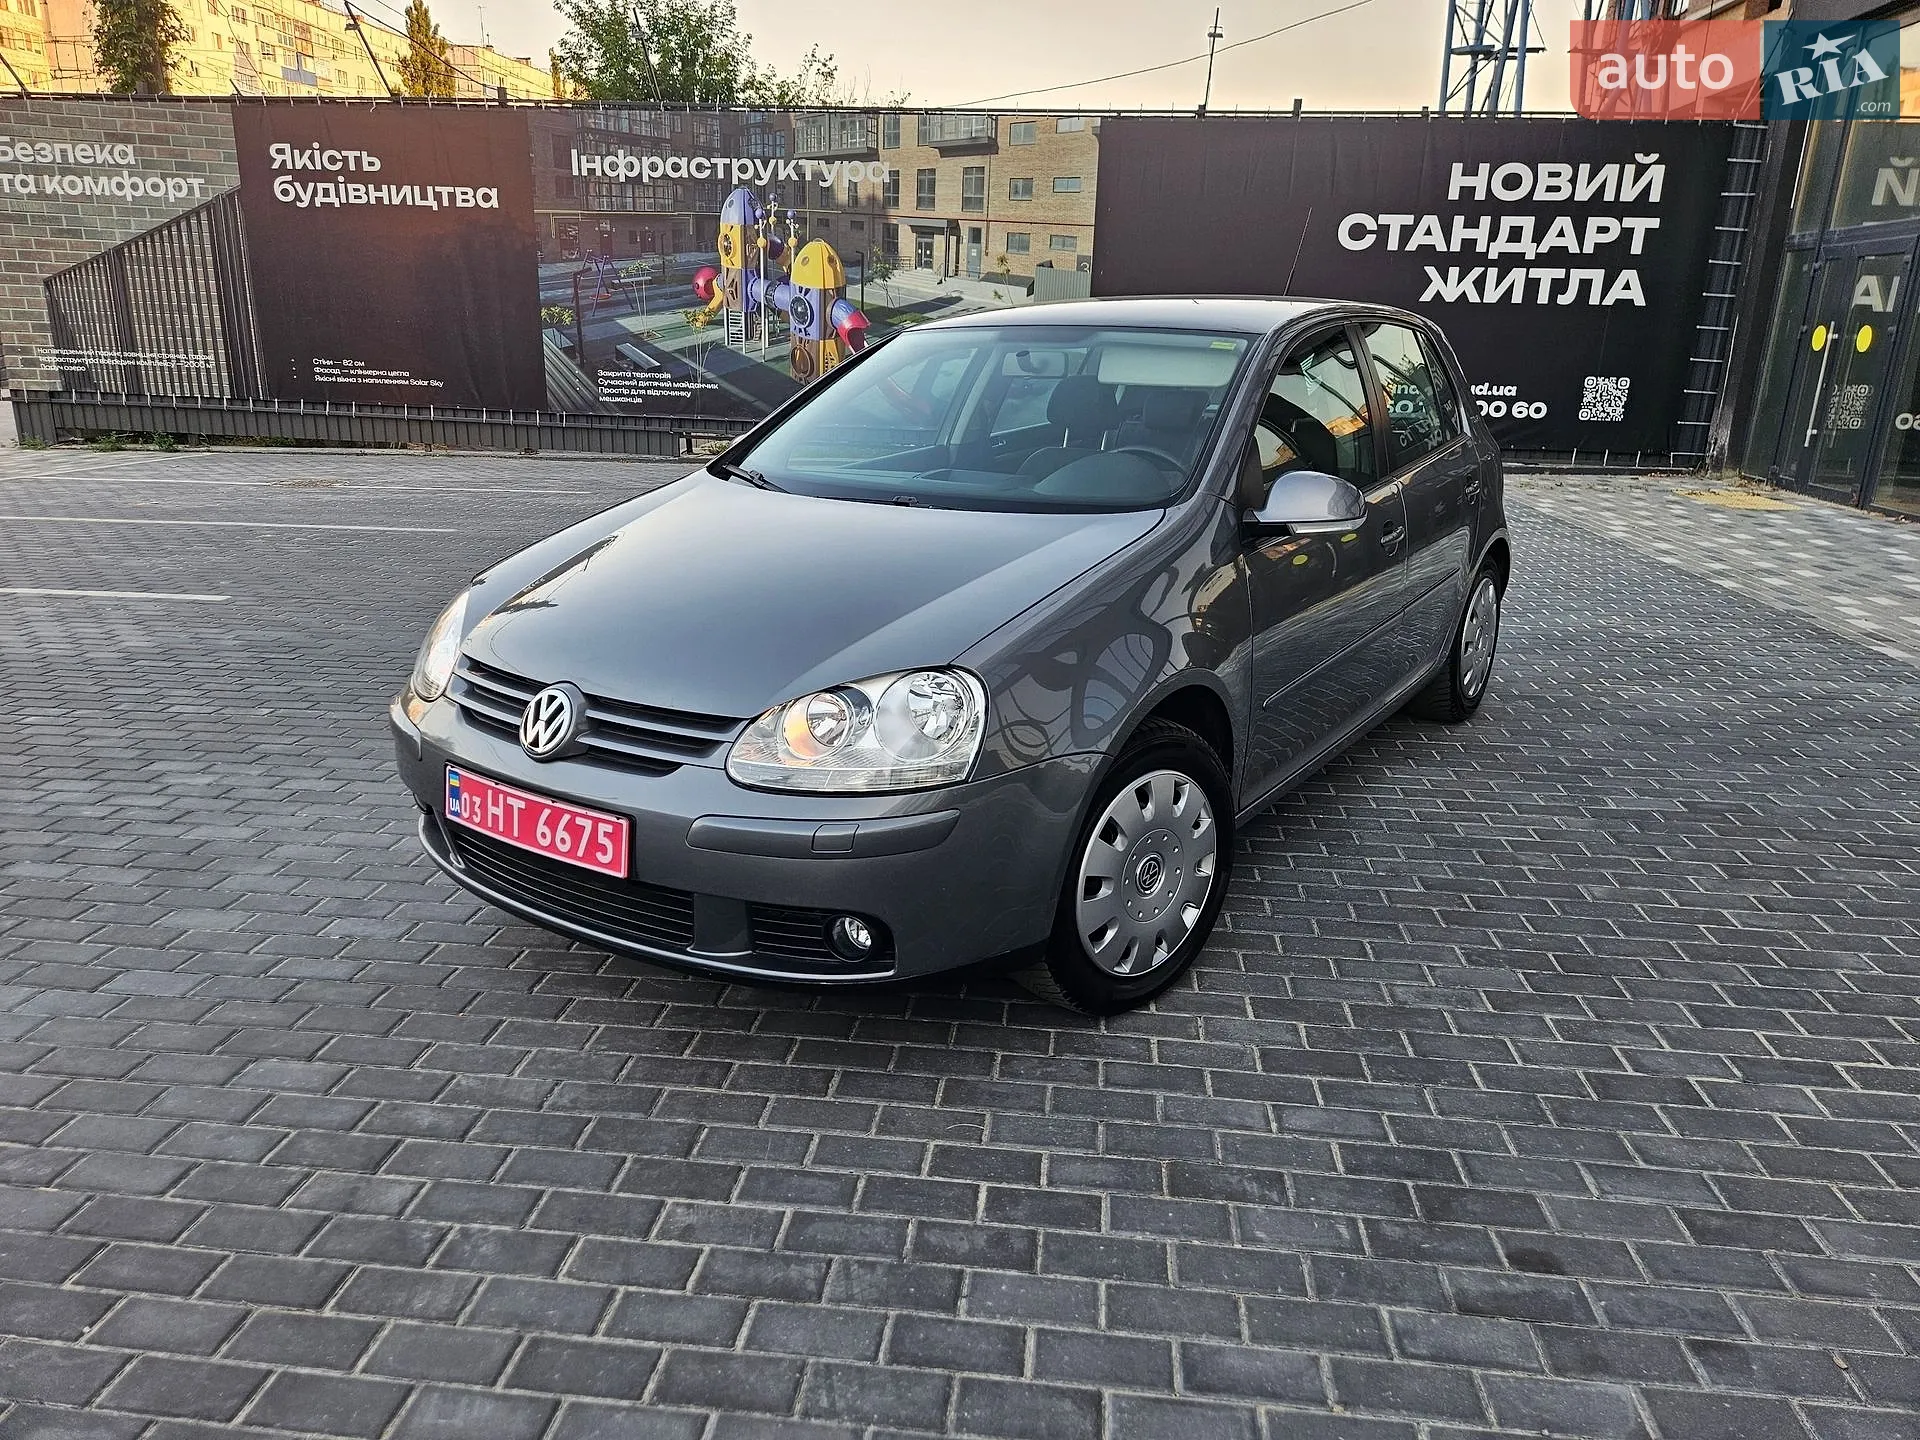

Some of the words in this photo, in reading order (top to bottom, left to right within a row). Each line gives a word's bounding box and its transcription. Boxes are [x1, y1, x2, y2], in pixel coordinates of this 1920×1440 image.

[269, 141, 382, 172] Якість
[570, 148, 891, 188] Інфраструктура
[0, 173, 37, 193] та
[44, 170, 205, 203] комфорт
[1448, 152, 1666, 203] НОВИЙ
[273, 174, 499, 211] будівництва
[1337, 212, 1661, 260] СТАНДАРТ
[1419, 266, 1646, 307] ЖИТЛА
[312, 358, 334, 366] Стіни
[342, 359, 353, 367] 82
[314, 366, 341, 375] Фасад
[350, 368, 387, 377] клінкерна
[409, 379, 429, 387] Solar
[430, 379, 444, 388] Sky
[597, 369, 631, 378] Закрита
[632, 371, 671, 380] територія
[597, 377, 638, 387] Сучасний
[638, 380, 672, 388] дитячий
[673, 381, 719, 390] майданчик
[598, 386, 630, 395] Простір
[630, 388, 646, 396] для
[647, 389, 692, 398] відпочинку
[599, 396, 643, 404] мешканців
[1511, 401, 1548, 419] 60
[449, 797, 461, 813] UA
[535, 808, 614, 864] 6675
